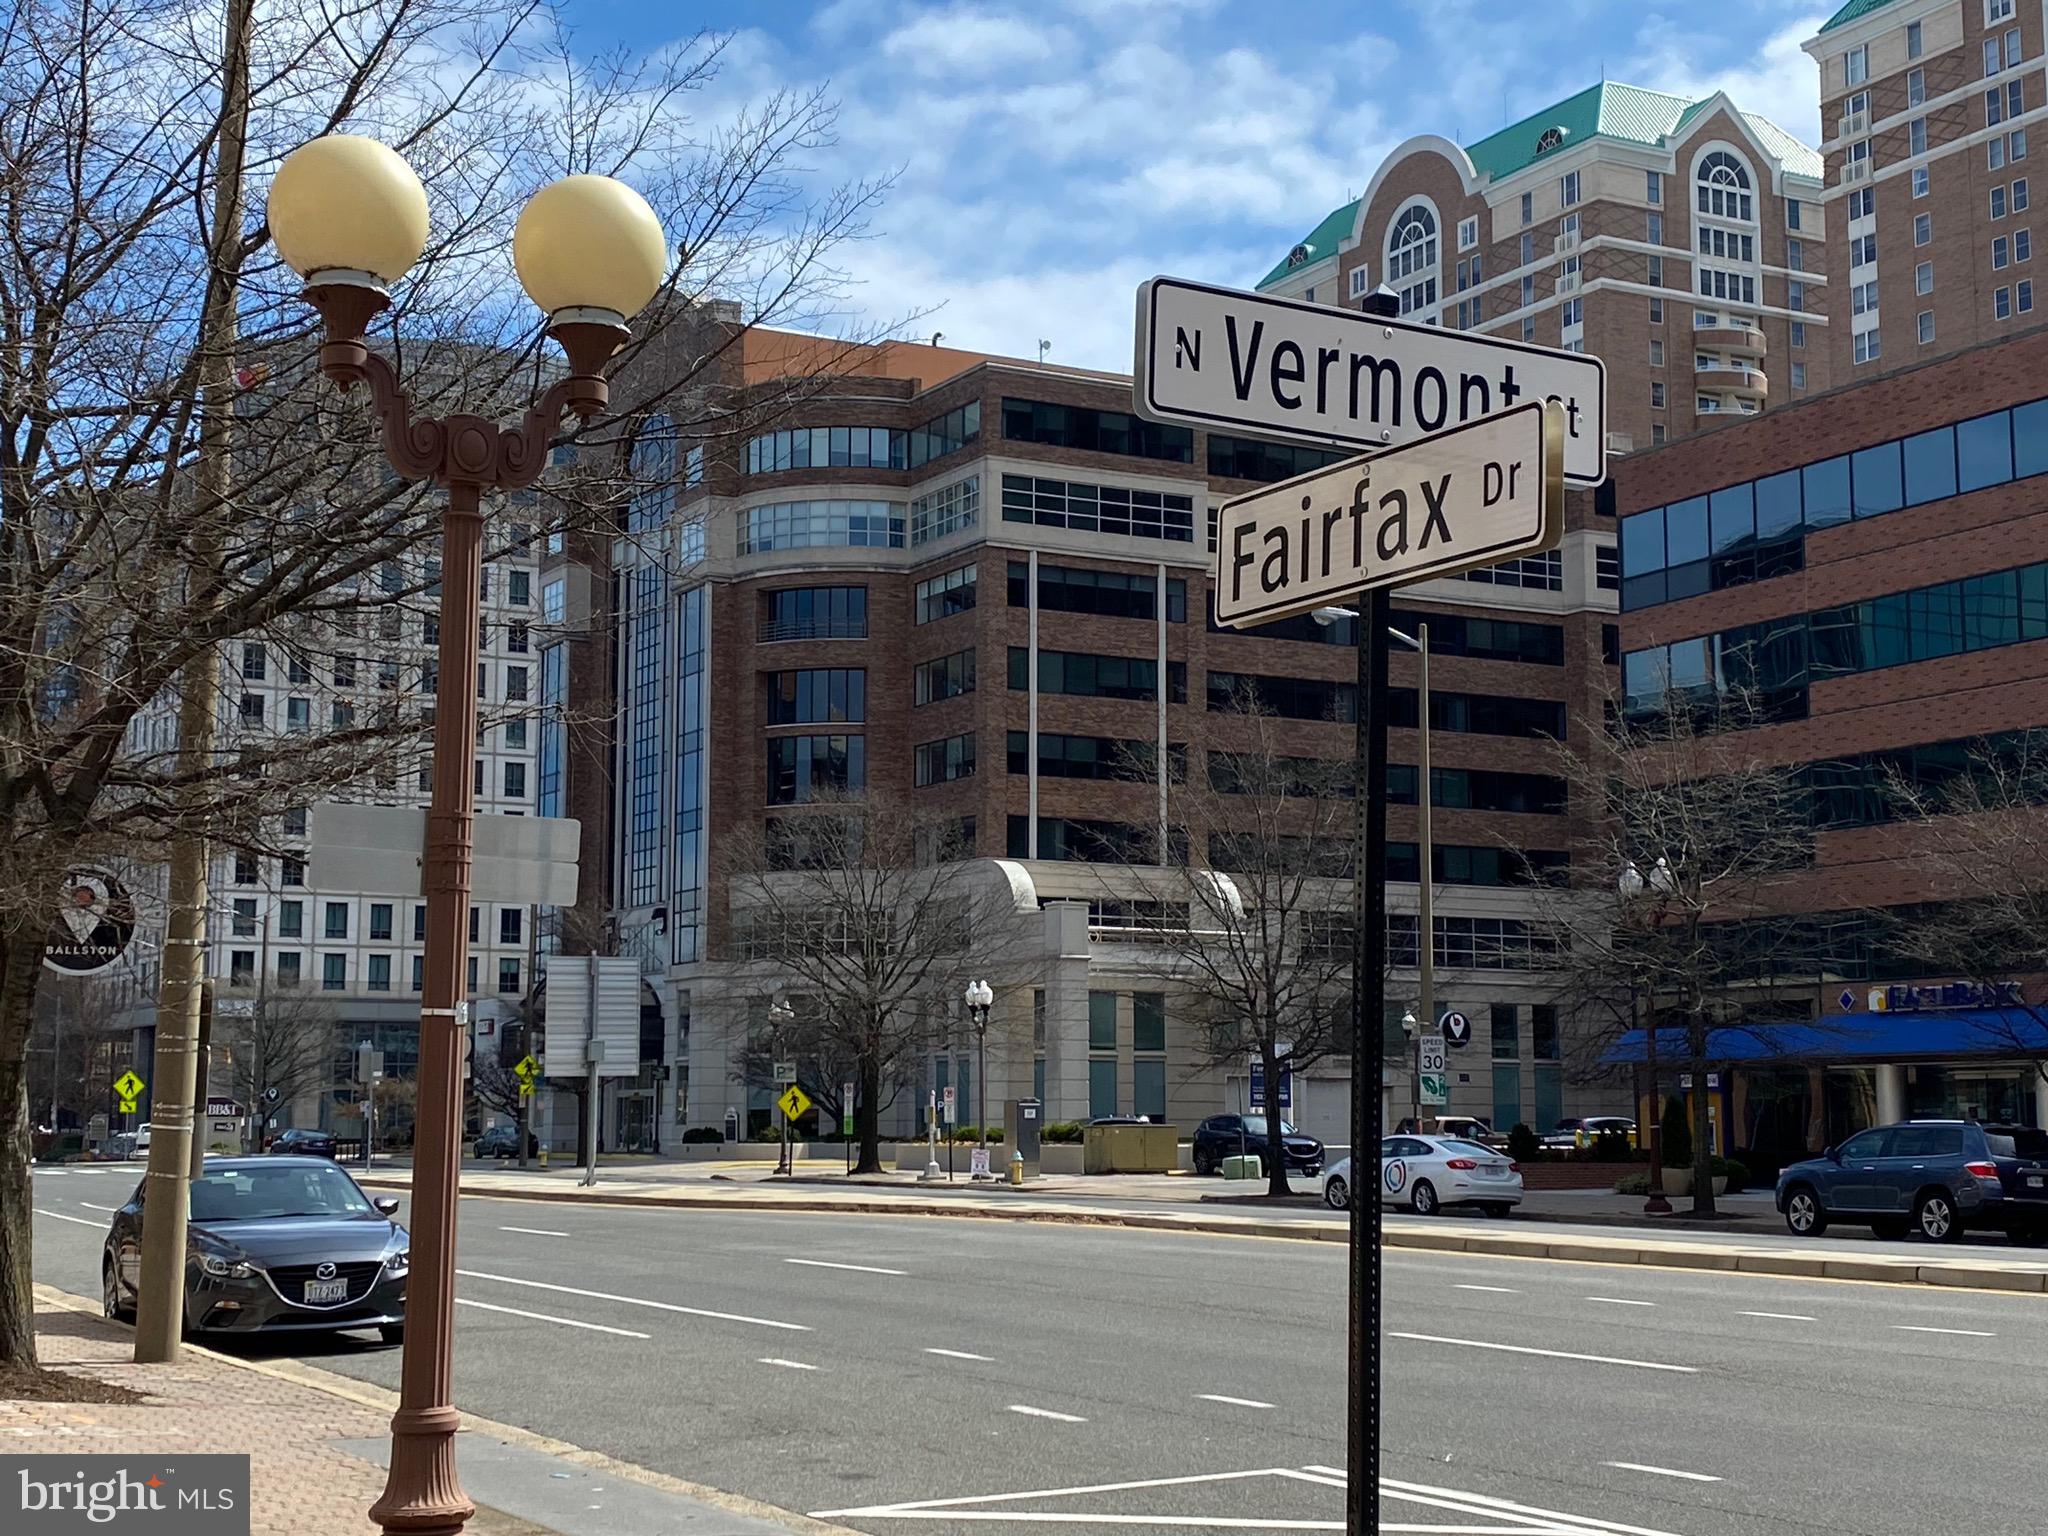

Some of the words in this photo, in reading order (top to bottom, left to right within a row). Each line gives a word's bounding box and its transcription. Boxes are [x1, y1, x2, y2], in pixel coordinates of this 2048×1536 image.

[1175, 326, 1201, 372] N
[1225, 315, 1520, 432] Vermont
[1232, 473, 1453, 603] Fairfax
[1483, 461, 1522, 508] Dr
[45, 945, 117, 955] BALLSTON
[1421, 1038, 1443, 1046] SPEED
[1422, 1055, 1443, 1070] 30
[207, 1104, 236, 1116] BB&T
